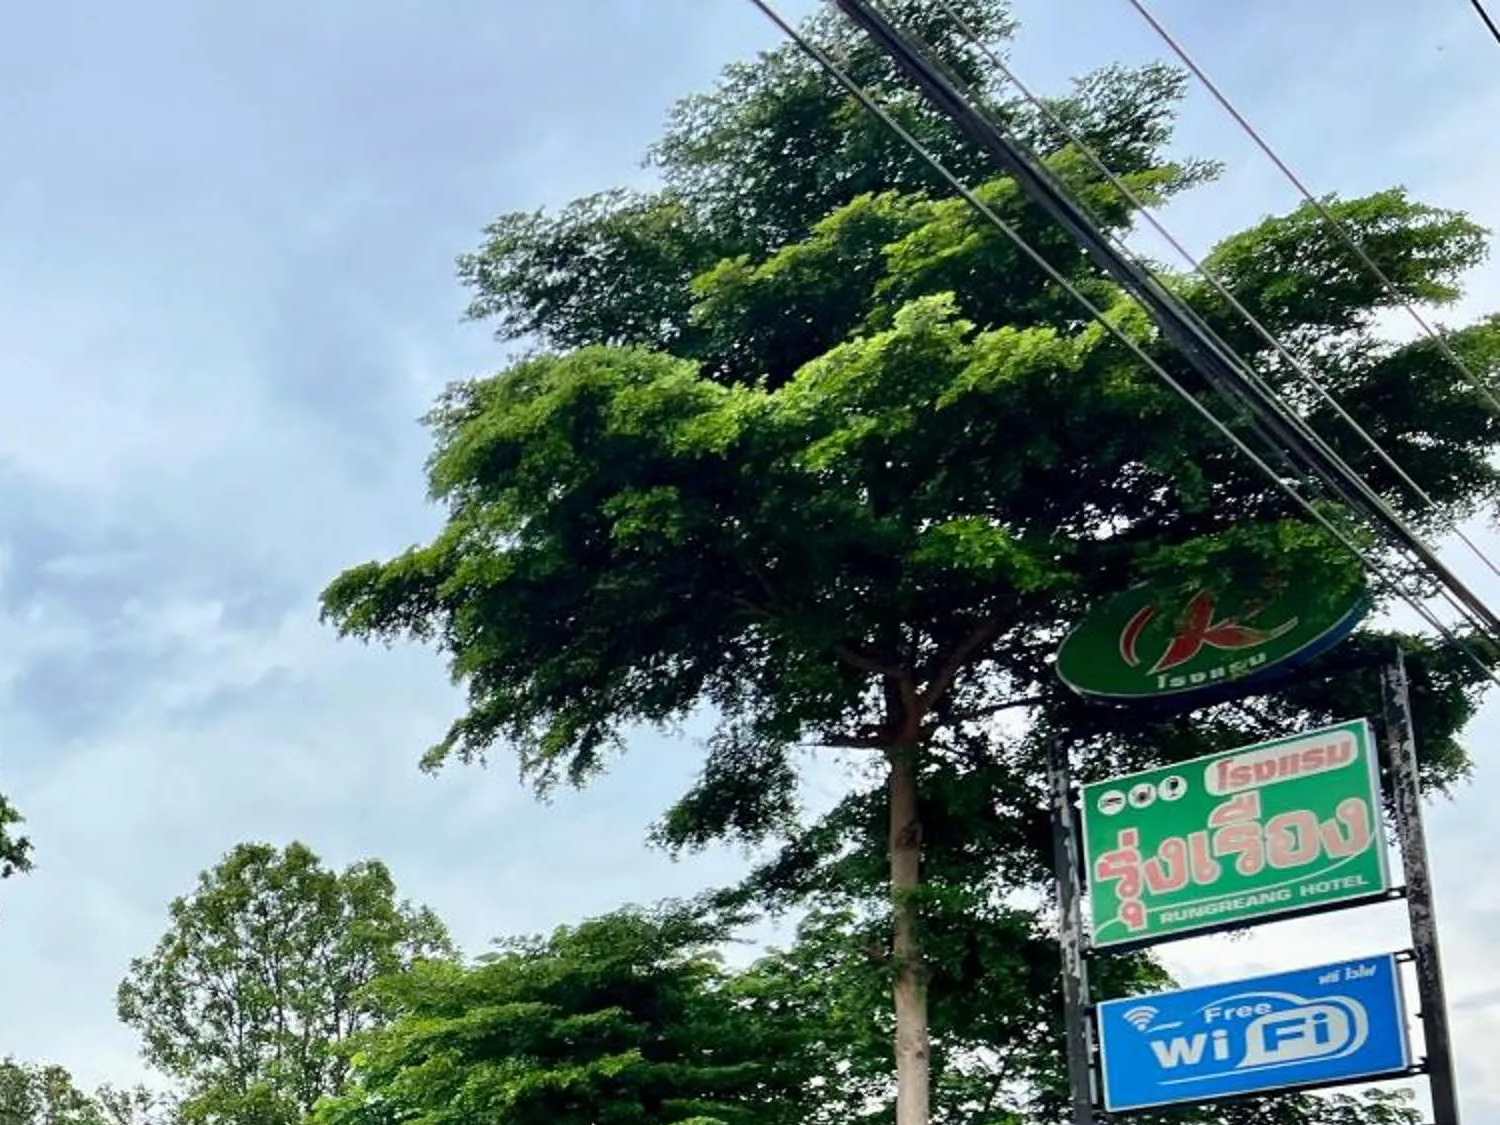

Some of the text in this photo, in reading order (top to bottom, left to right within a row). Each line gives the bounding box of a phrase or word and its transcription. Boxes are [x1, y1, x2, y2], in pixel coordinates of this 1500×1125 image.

[1216, 740, 1352, 790] โรงแรม
[1095, 790, 1370, 931] รุ่งเรือง
[1160, 875, 1369, 924] RUNGREANG HOTEL
[1203, 1003, 1274, 1024] Free
